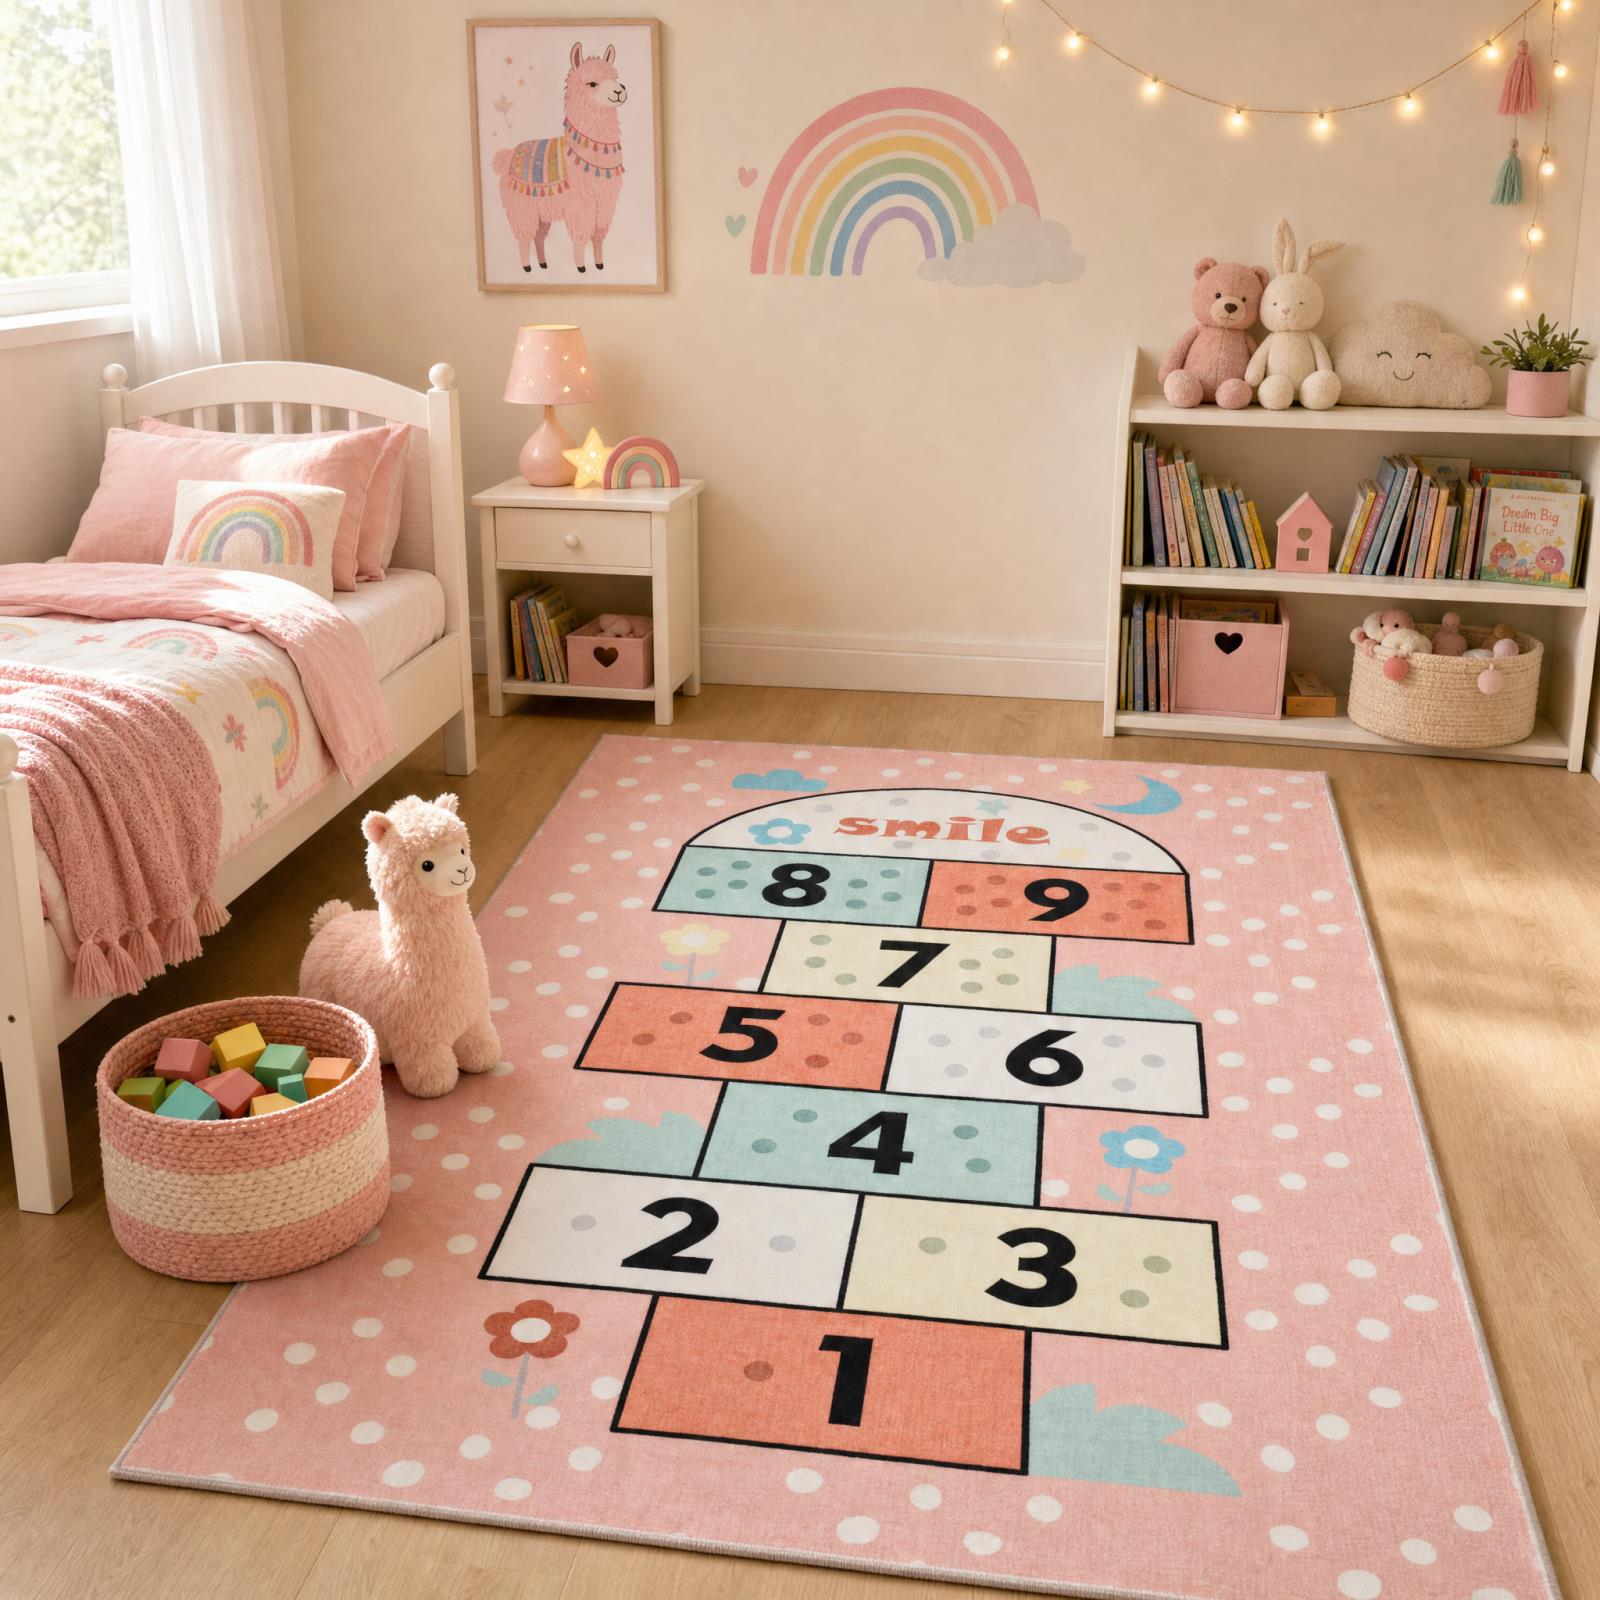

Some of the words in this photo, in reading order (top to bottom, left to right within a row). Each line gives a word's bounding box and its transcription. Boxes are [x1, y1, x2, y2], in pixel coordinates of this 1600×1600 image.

[1502, 505, 1536, 520] Dream
[1540, 508, 1559, 527] Big
[1503, 521, 1531, 534] Little
[1534, 524, 1554, 537] One
[833, 815, 1051, 845] smile
[762, 864, 830, 907] 8
[1024, 878, 1089, 921] 9
[878, 940, 950, 988] 7
[700, 1006, 785, 1063] 5
[1006, 1030, 1083, 1086] 6
[828, 1112, 913, 1175] 4
[620, 1198, 718, 1274] 2
[985, 1228, 1077, 1307] 3
[819, 1335, 874, 1427] 1
